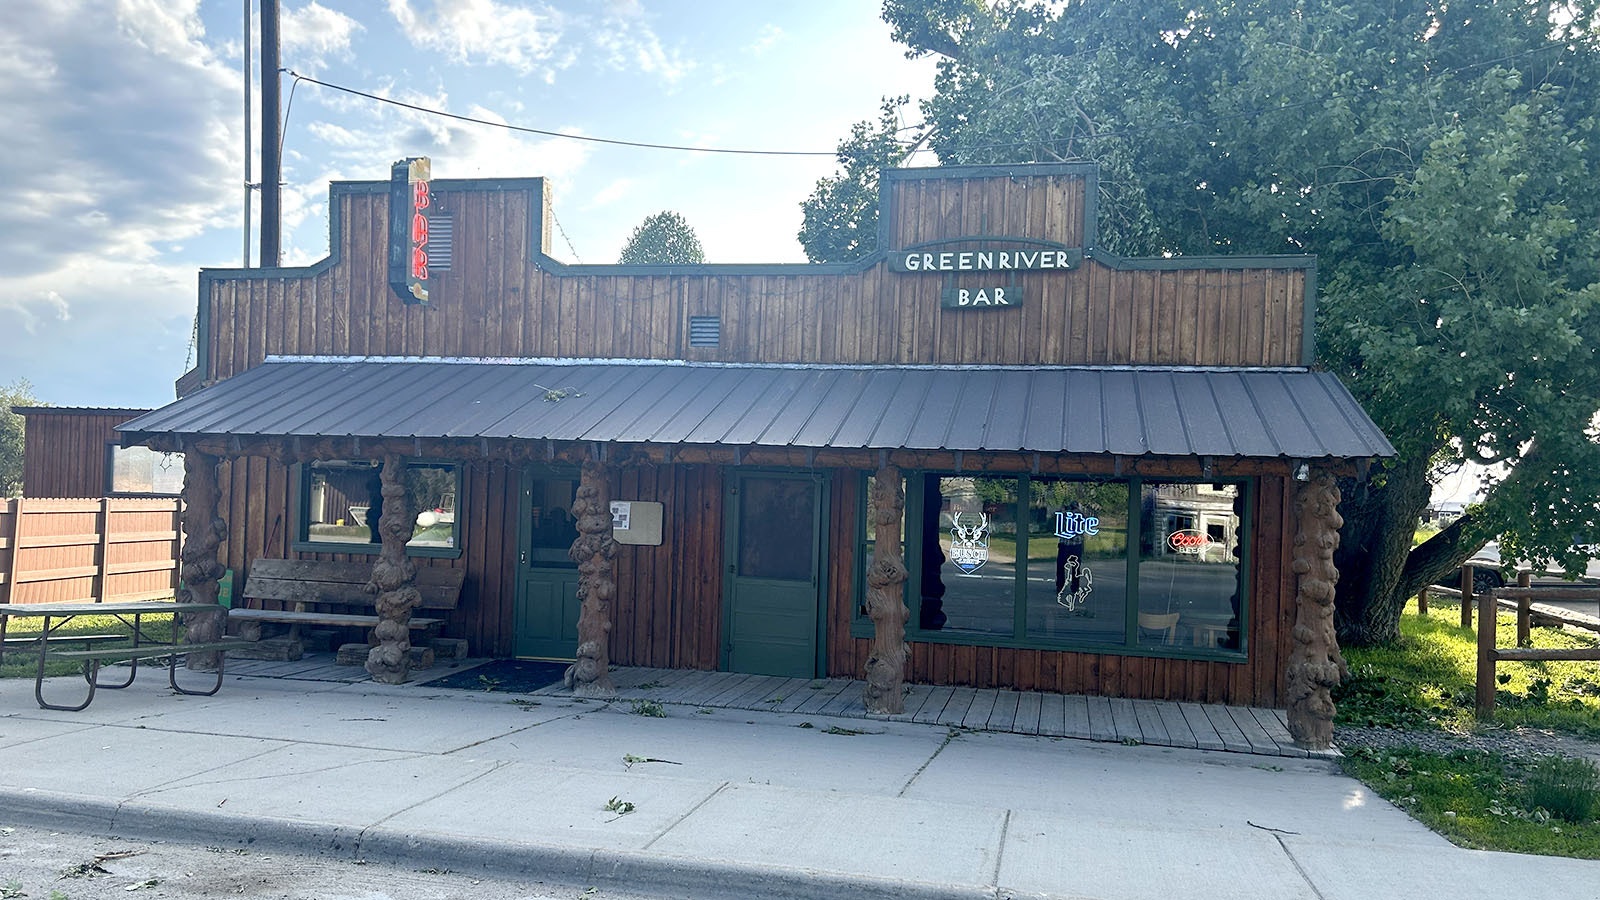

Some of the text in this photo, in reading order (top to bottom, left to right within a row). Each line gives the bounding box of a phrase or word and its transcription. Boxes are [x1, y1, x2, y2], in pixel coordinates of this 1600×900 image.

[412, 179, 429, 280] BAR
[957, 287, 1009, 306] BAR
[1054, 511, 1099, 539] Lite
[951, 547, 987, 560] BUSCH
